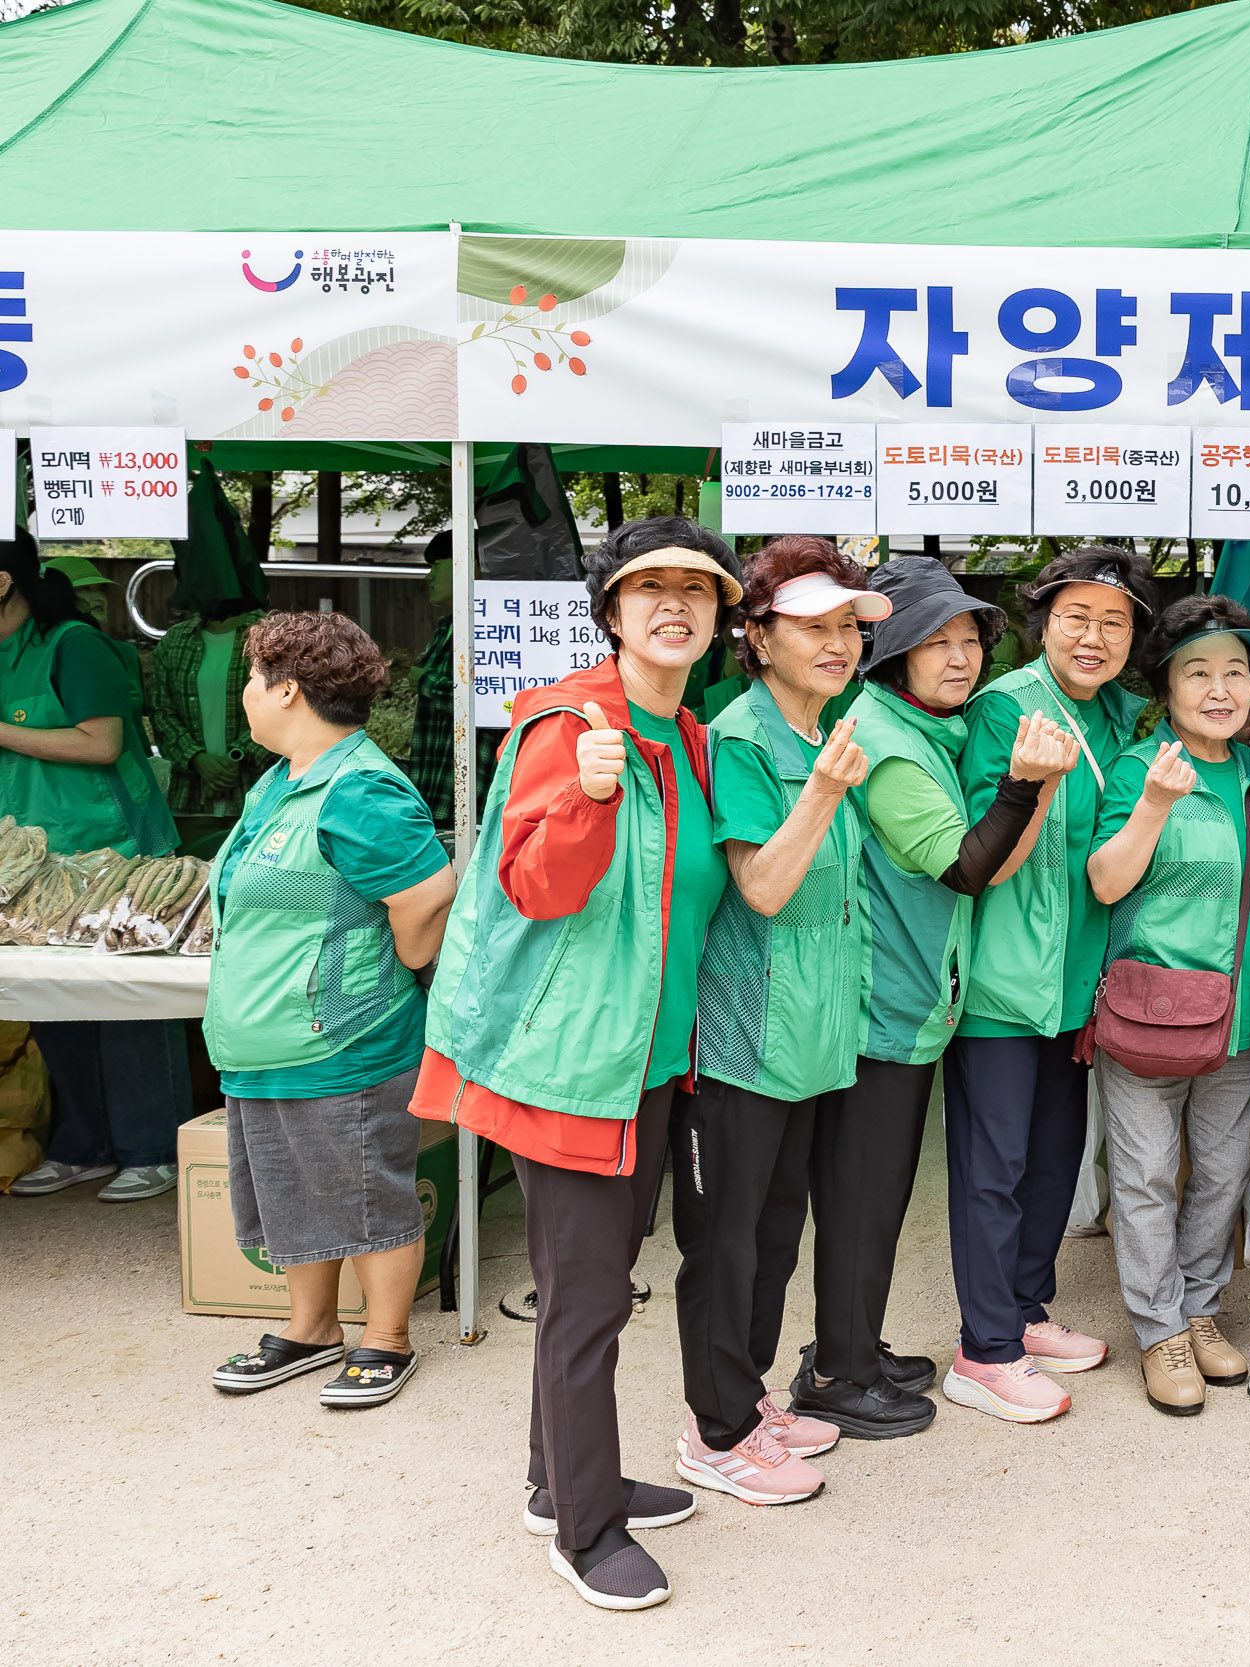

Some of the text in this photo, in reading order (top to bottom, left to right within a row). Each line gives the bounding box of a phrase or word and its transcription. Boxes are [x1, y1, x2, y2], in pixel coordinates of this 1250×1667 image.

[312, 249, 395, 265] 소통하며 발전하는
[311, 264, 394, 294] 행복광진
[753, 431, 843, 449] 새마을금고
[41, 452, 91, 470] 모시떡
[883, 446, 1023, 466] 도토리묵(국산)
[1043, 446, 1180, 467] 도토리묵(중국산)
[724, 460, 873, 476] (제향란 새마을부녀회)
[44, 480, 93, 498] 뻥튀기
[725, 484, 872, 498] 9002-2056-1742-8
[908, 480, 998, 503] 5,000원
[1066, 480, 1157, 503] 3,000원
[51, 507, 85, 525] (2개)
[529, 600, 560, 620] 1kg
[474, 625, 611, 646] 도라지 1kg 16,0
[474, 651, 521, 669] 모시떡
